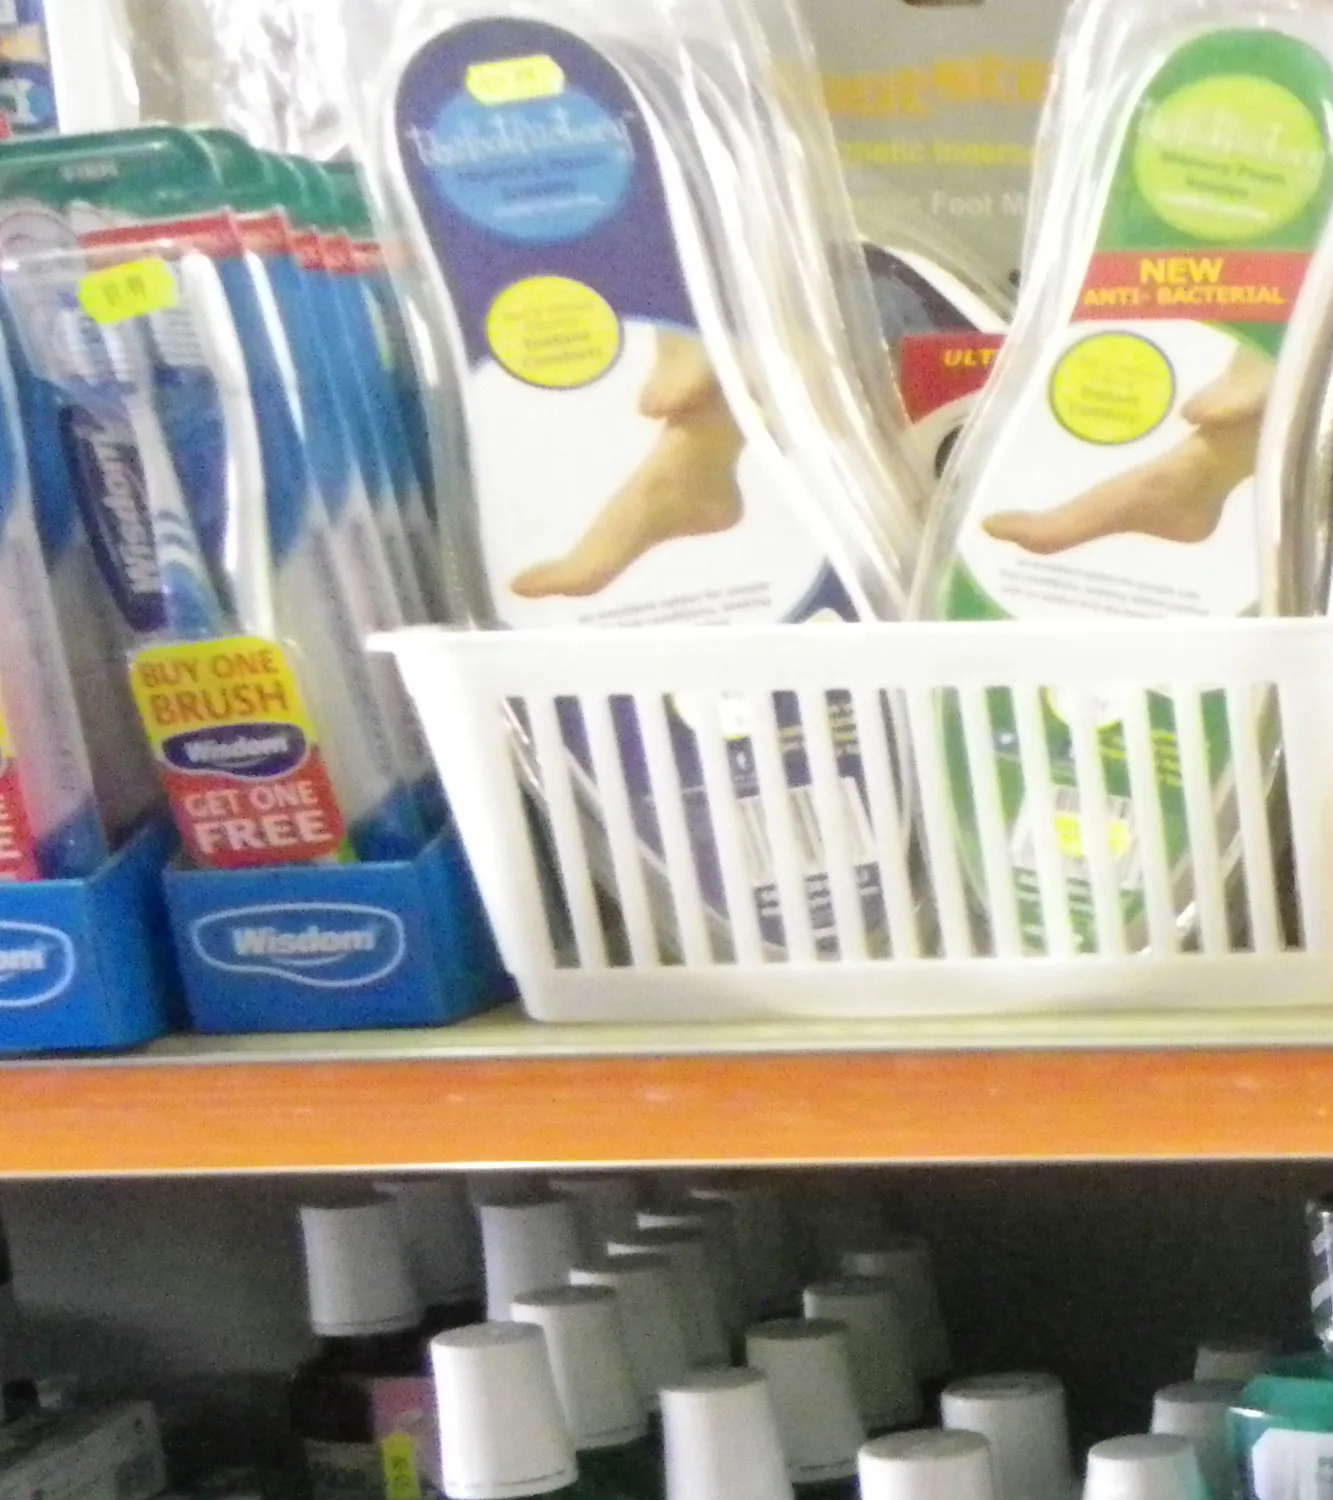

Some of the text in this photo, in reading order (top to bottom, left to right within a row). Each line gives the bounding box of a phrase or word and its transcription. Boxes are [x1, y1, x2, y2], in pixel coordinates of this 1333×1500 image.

[1141, 257, 1223, 284] NEW
[1157, 284, 1285, 305] BACTERIAL
[944, 347, 997, 367] ULT
[141, 649, 279, 687] BUY ONE
[150, 684, 289, 727] BRUSH
[184, 734, 288, 766] Wisdom
[184, 778, 320, 819] GET ONE
[199, 809, 333, 855] FREE
[233, 924, 376, 957] Wisdom
